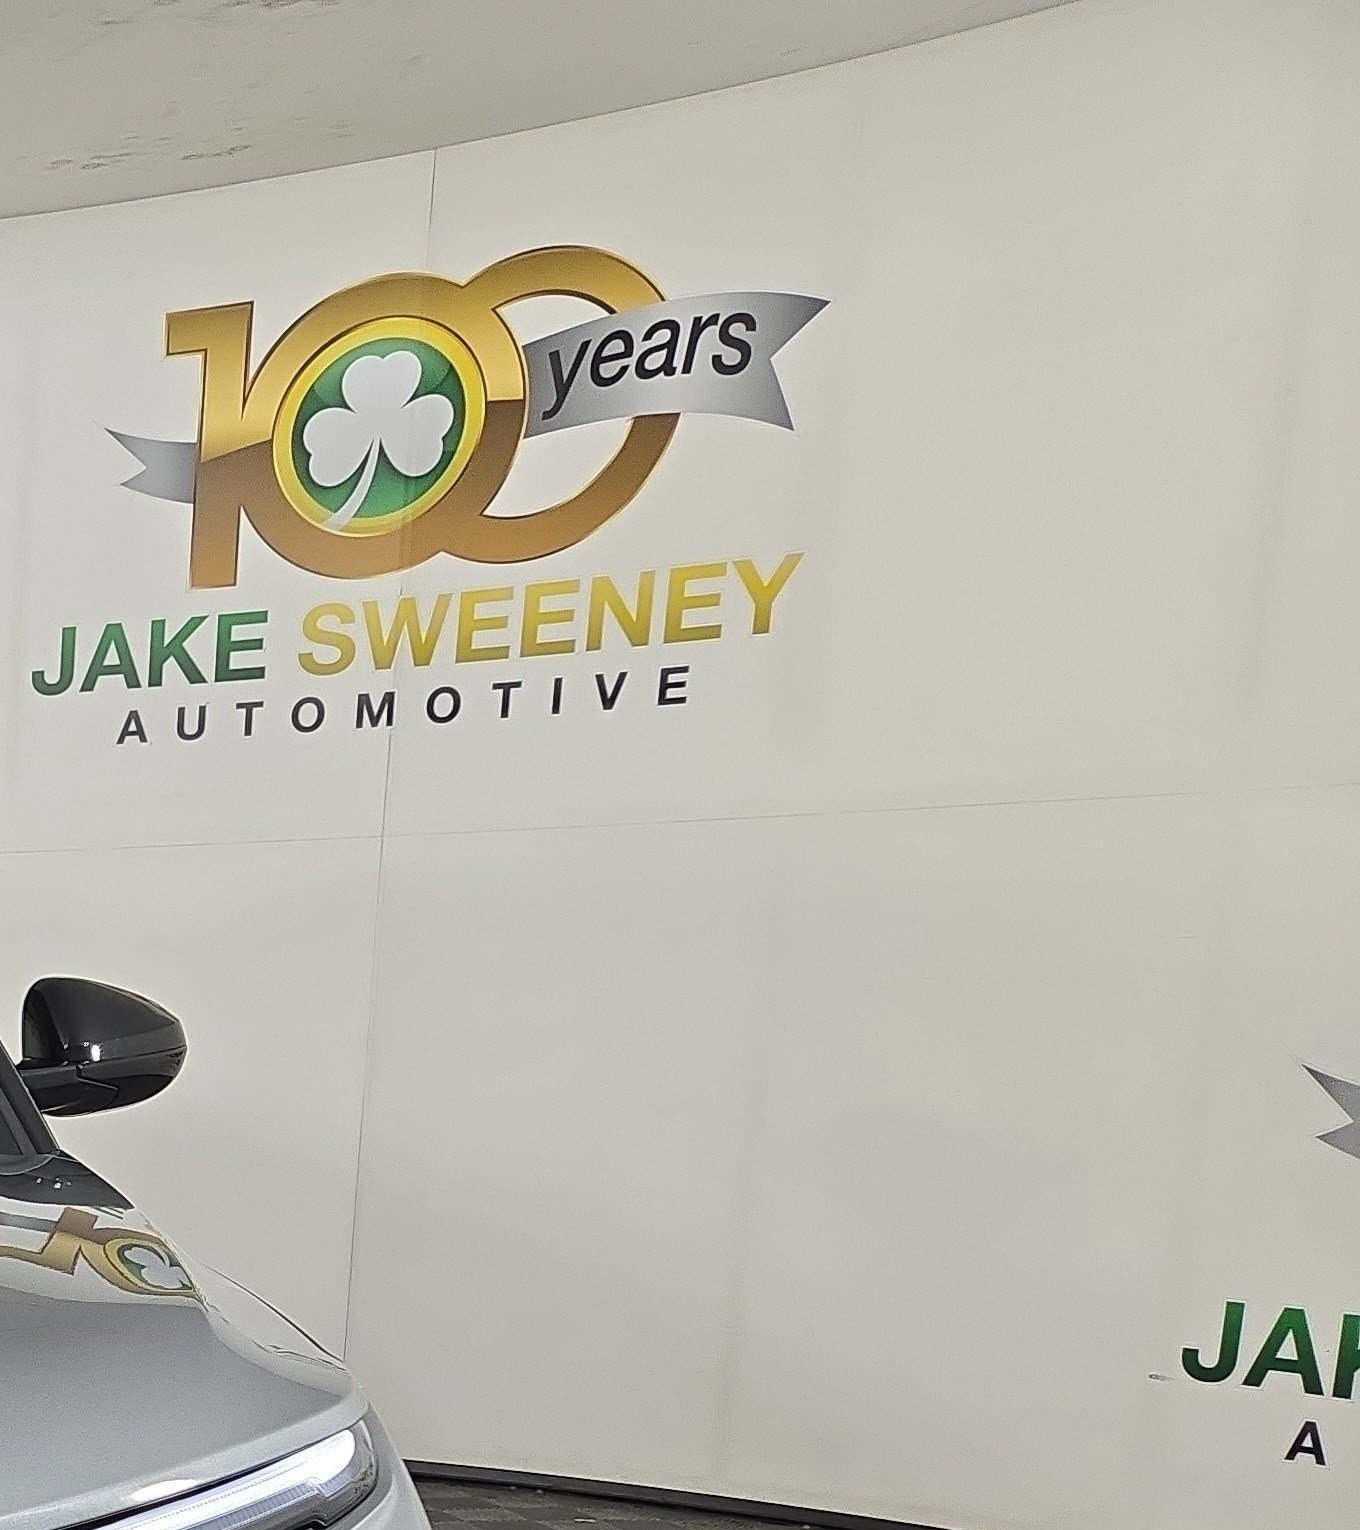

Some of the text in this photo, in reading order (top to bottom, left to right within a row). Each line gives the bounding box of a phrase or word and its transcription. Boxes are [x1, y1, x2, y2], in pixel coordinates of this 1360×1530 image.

[164, 244, 683, 589] 100
[541, 307, 758, 421] years
[30, 552, 806, 697] JAKE SWEENEY
[115, 665, 692, 746] AUTOMOTIVE
